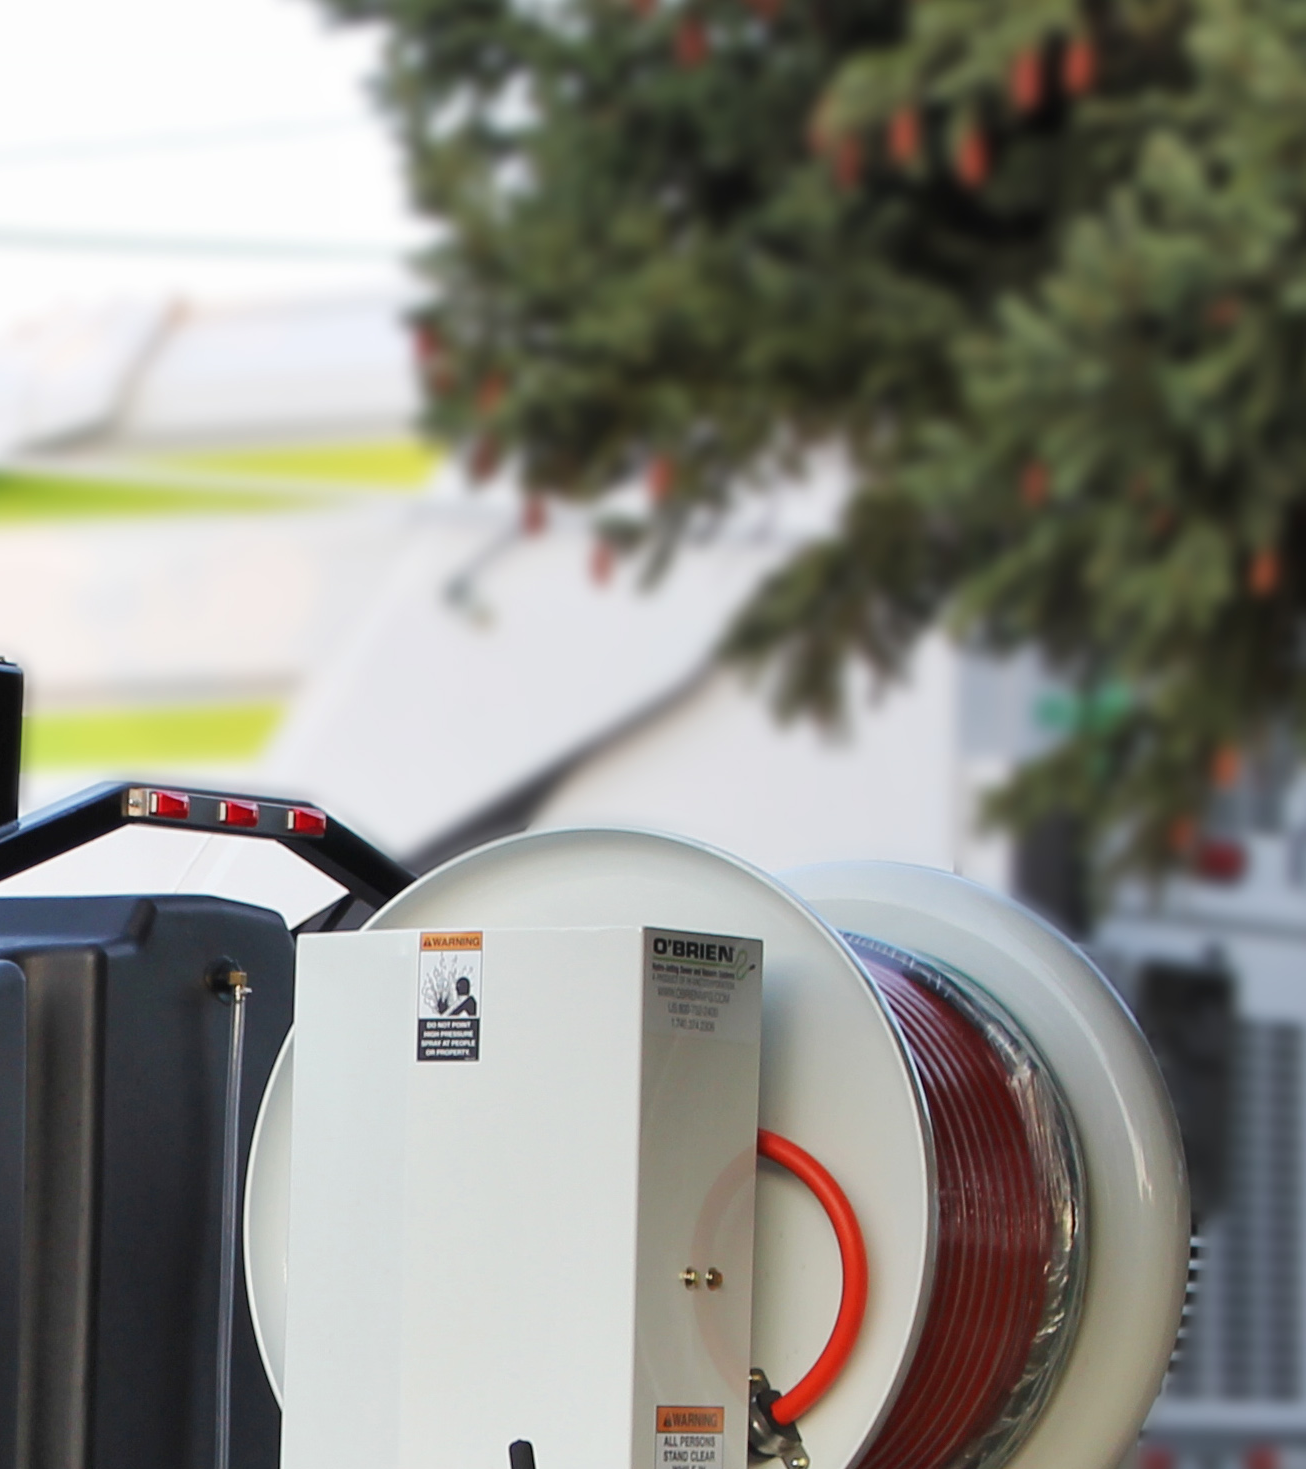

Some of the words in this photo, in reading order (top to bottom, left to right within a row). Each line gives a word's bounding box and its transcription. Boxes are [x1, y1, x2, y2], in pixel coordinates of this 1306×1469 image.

[432, 935, 481, 947] WARNING
[653, 938, 734, 963] O'BRIEN
[427, 1021, 436, 1029] DO
[437, 1021, 450, 1029] NOT
[451, 1021, 471, 1029] POINT
[440, 1030, 473, 1038] PRESSURE
[442, 1039, 450, 1047] AT
[672, 1413, 717, 1427] WARNING
[663, 1436, 678, 1447] ALL
[680, 1436, 715, 1447] PERSONS
[663, 1450, 688, 1462] STAND
[690, 1450, 715, 1462] CLEAR
